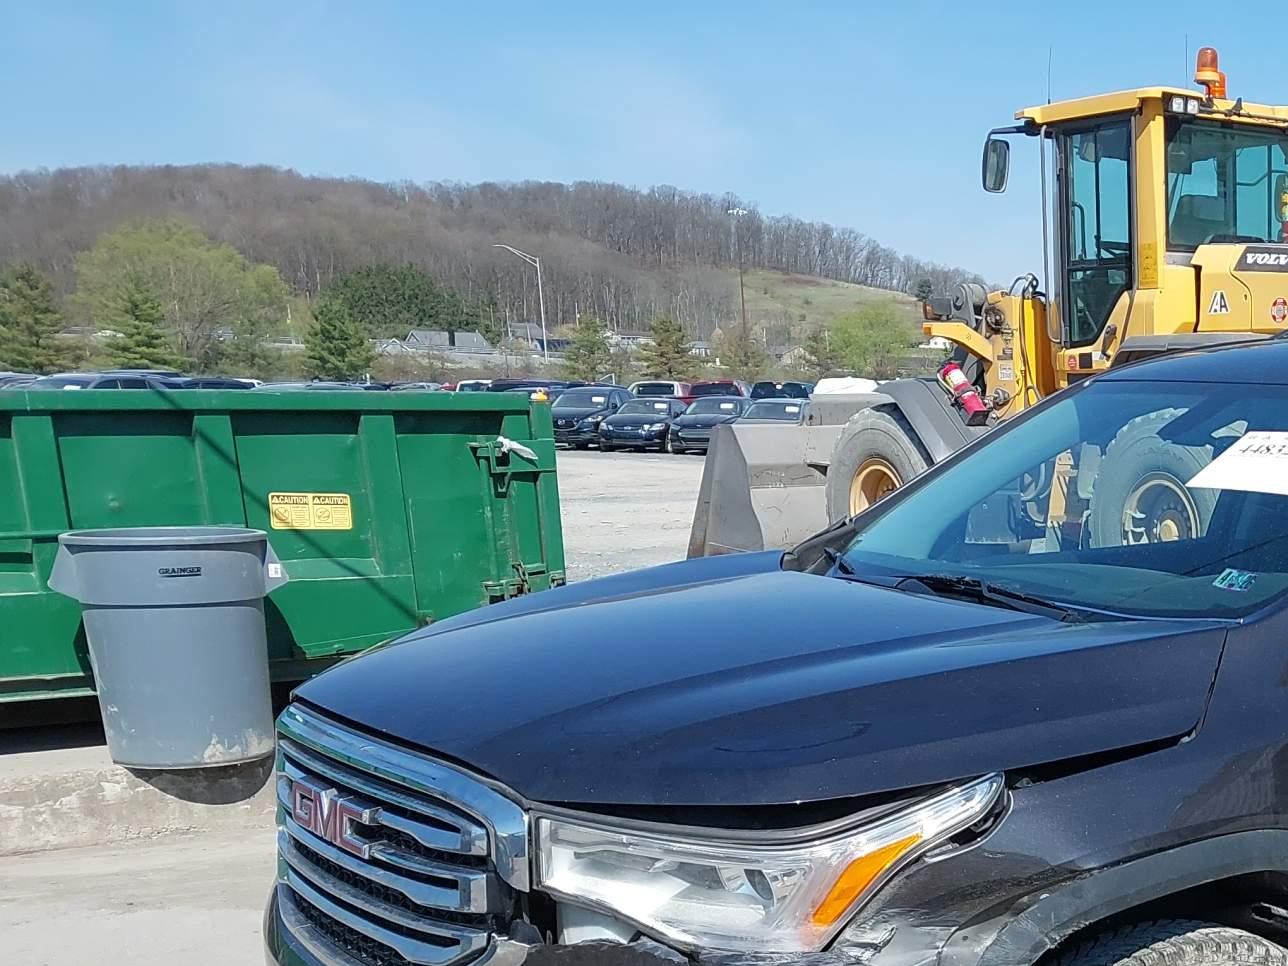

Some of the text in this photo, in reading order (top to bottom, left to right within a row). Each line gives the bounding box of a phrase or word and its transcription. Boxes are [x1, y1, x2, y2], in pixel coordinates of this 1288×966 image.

[280, 495, 308, 504] CAUTION
[320, 496, 348, 505] CAUTION
[158, 566, 202, 575] GRAINGER
[292, 778, 371, 860] GMC
